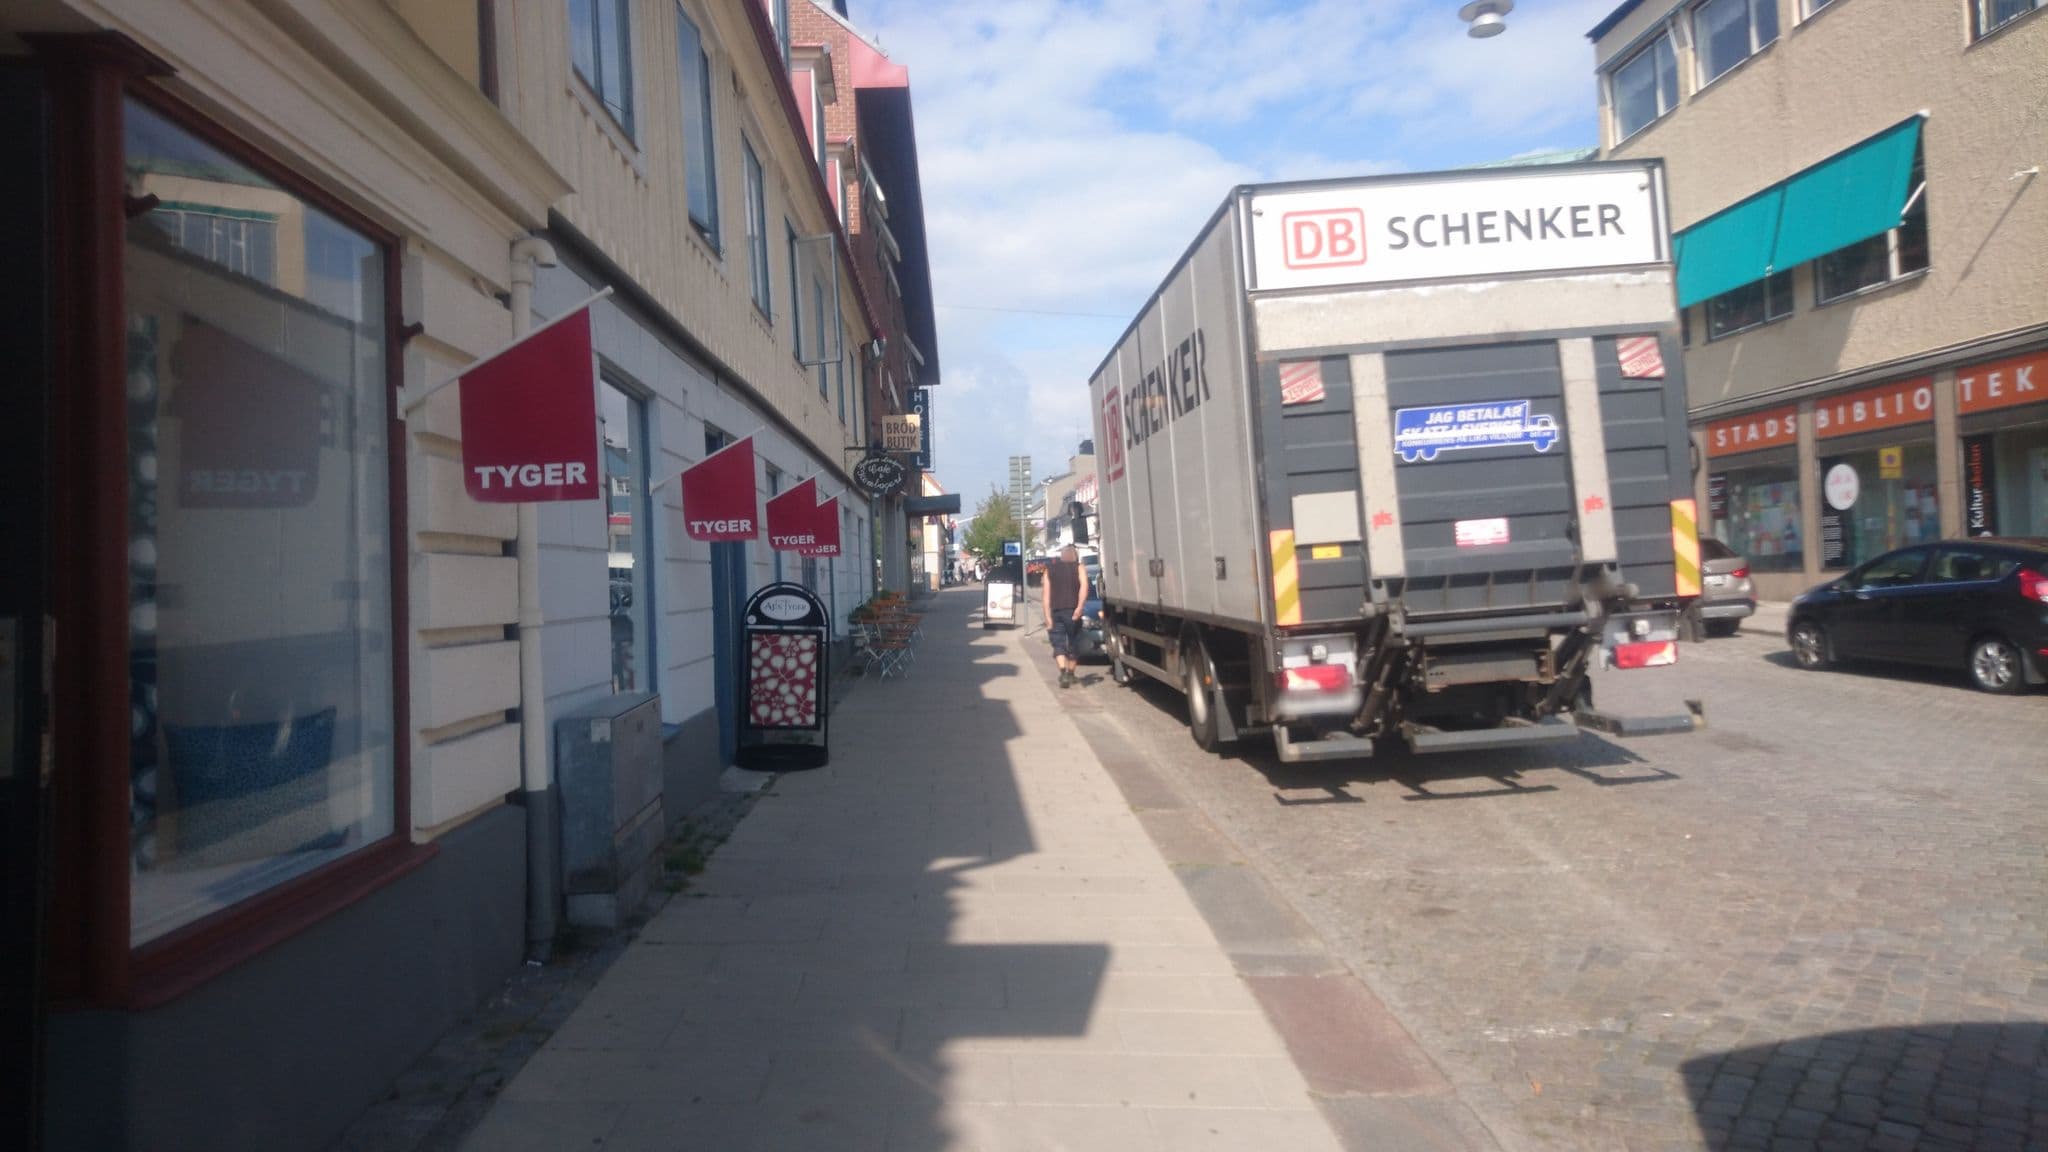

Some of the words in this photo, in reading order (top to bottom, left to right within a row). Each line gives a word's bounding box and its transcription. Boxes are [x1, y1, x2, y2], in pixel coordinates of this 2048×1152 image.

[1293, 217, 1357, 260] DB
[1387, 203, 1625, 251] SCHENKER
[1124, 328, 1211, 450] SCHENKER
[1426, 411, 1453, 425] JAG
[1459, 404, 1522, 421] BETALAR
[887, 436, 917, 448] BUTIK
[474, 462, 588, 488] TYGER
[690, 519, 752, 533] TYGER
[772, 535, 815, 545] TYGER
